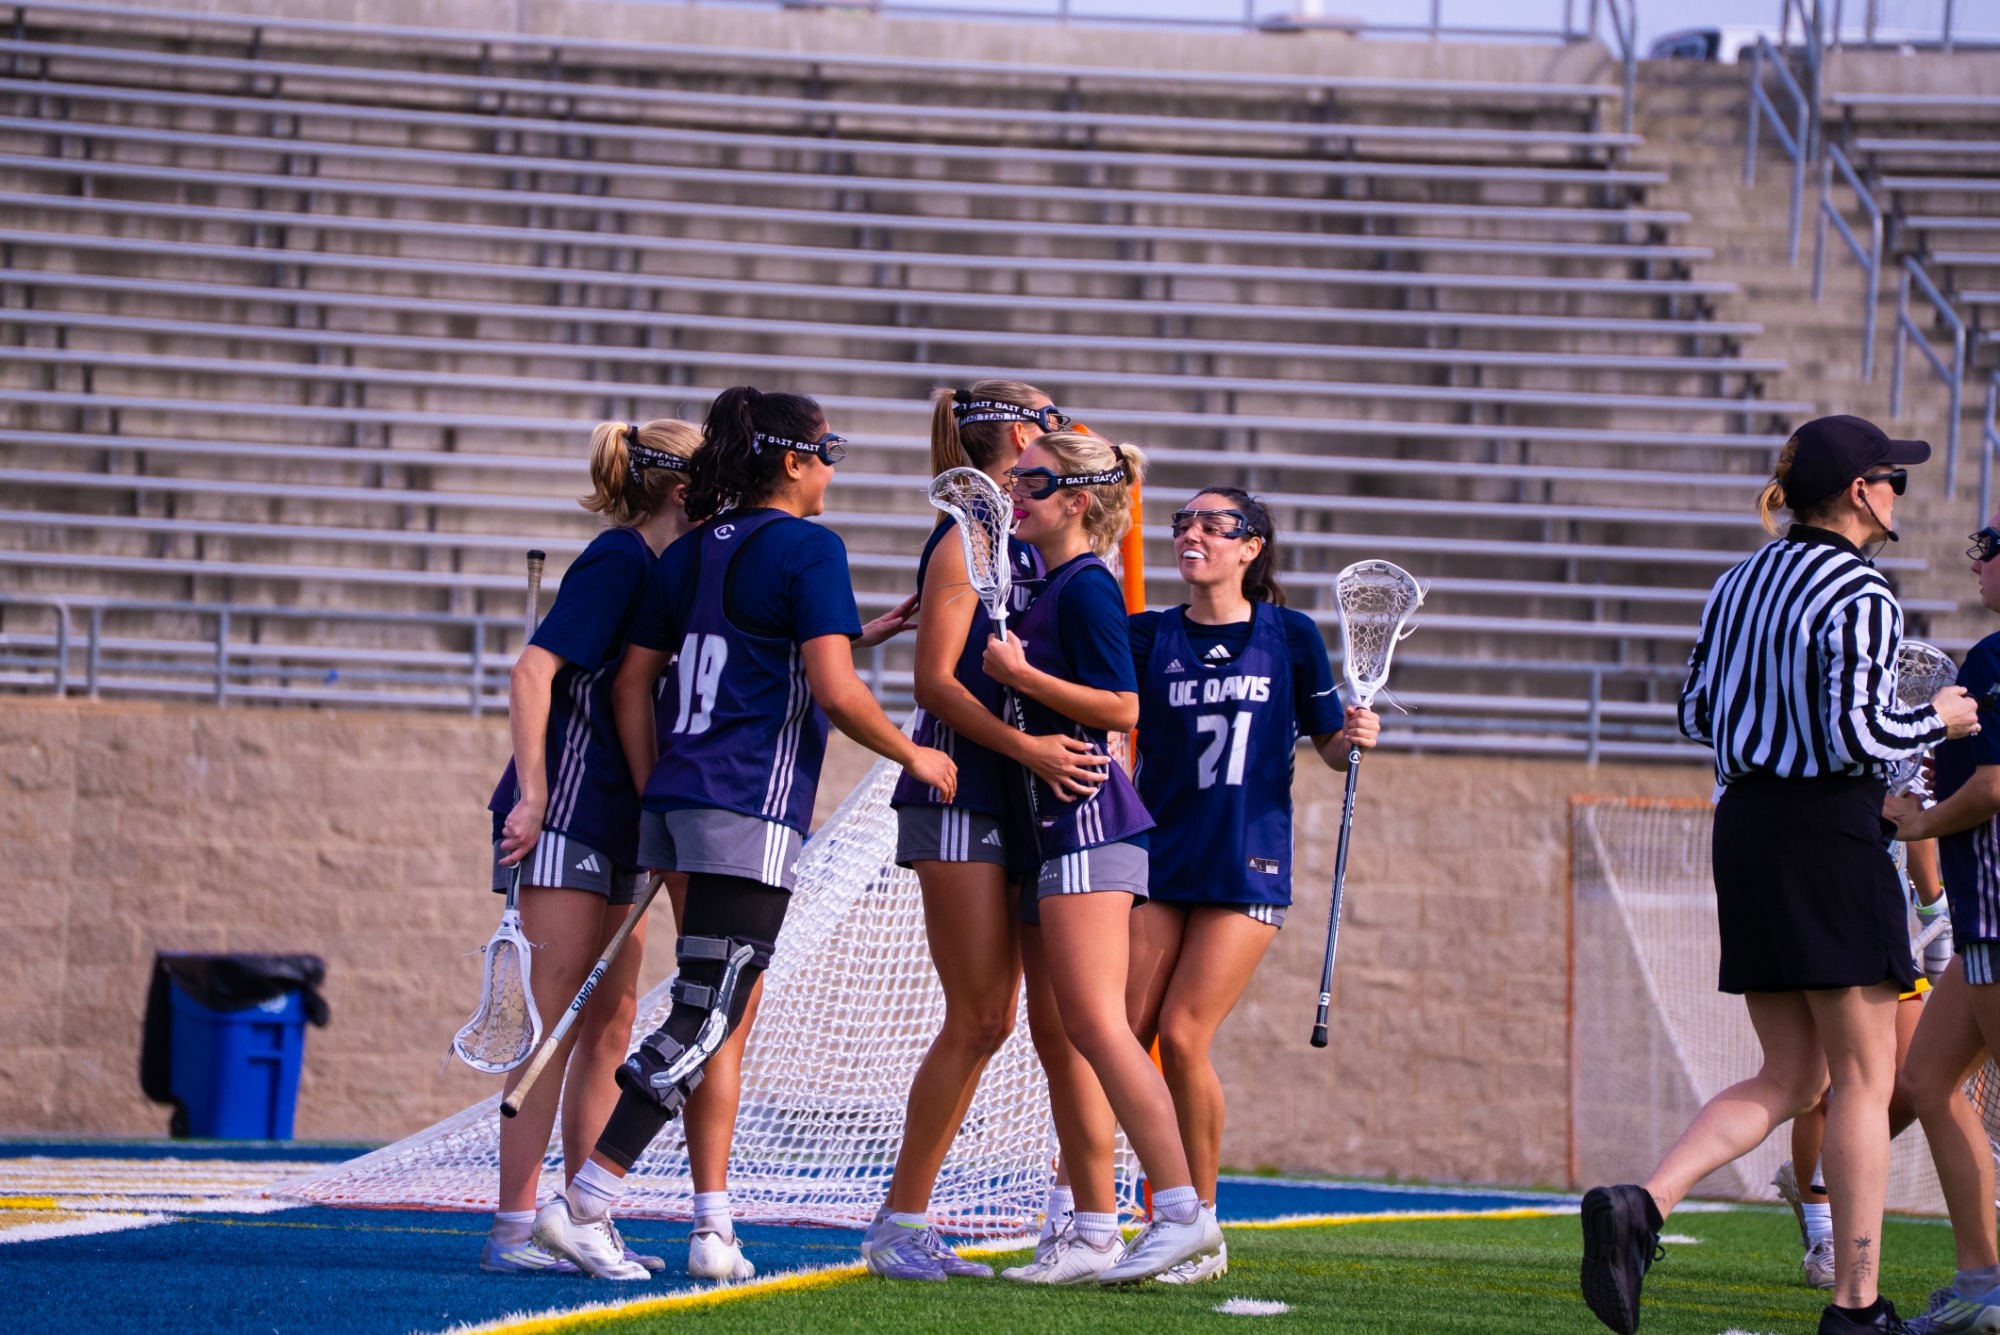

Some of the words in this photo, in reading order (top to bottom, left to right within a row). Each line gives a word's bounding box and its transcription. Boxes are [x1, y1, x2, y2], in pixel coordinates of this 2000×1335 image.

[970, 401, 992, 409] GAIT
[995, 402, 1020, 413] GAIT
[1022, 408, 1041, 419] GAI
[768, 436, 793, 447] GAIT
[795, 442, 820, 452] GAIT
[657, 459, 683, 469] GAIT
[1065, 476, 1090, 485] GAIT
[671, 632, 728, 735] 19
[1169, 680, 1198, 707] UC
[1203, 675, 1271, 704] DAVIS
[1196, 711, 1253, 790] 21
[591, 967, 604, 981] UC
[571, 980, 595, 1011] DAVIS
